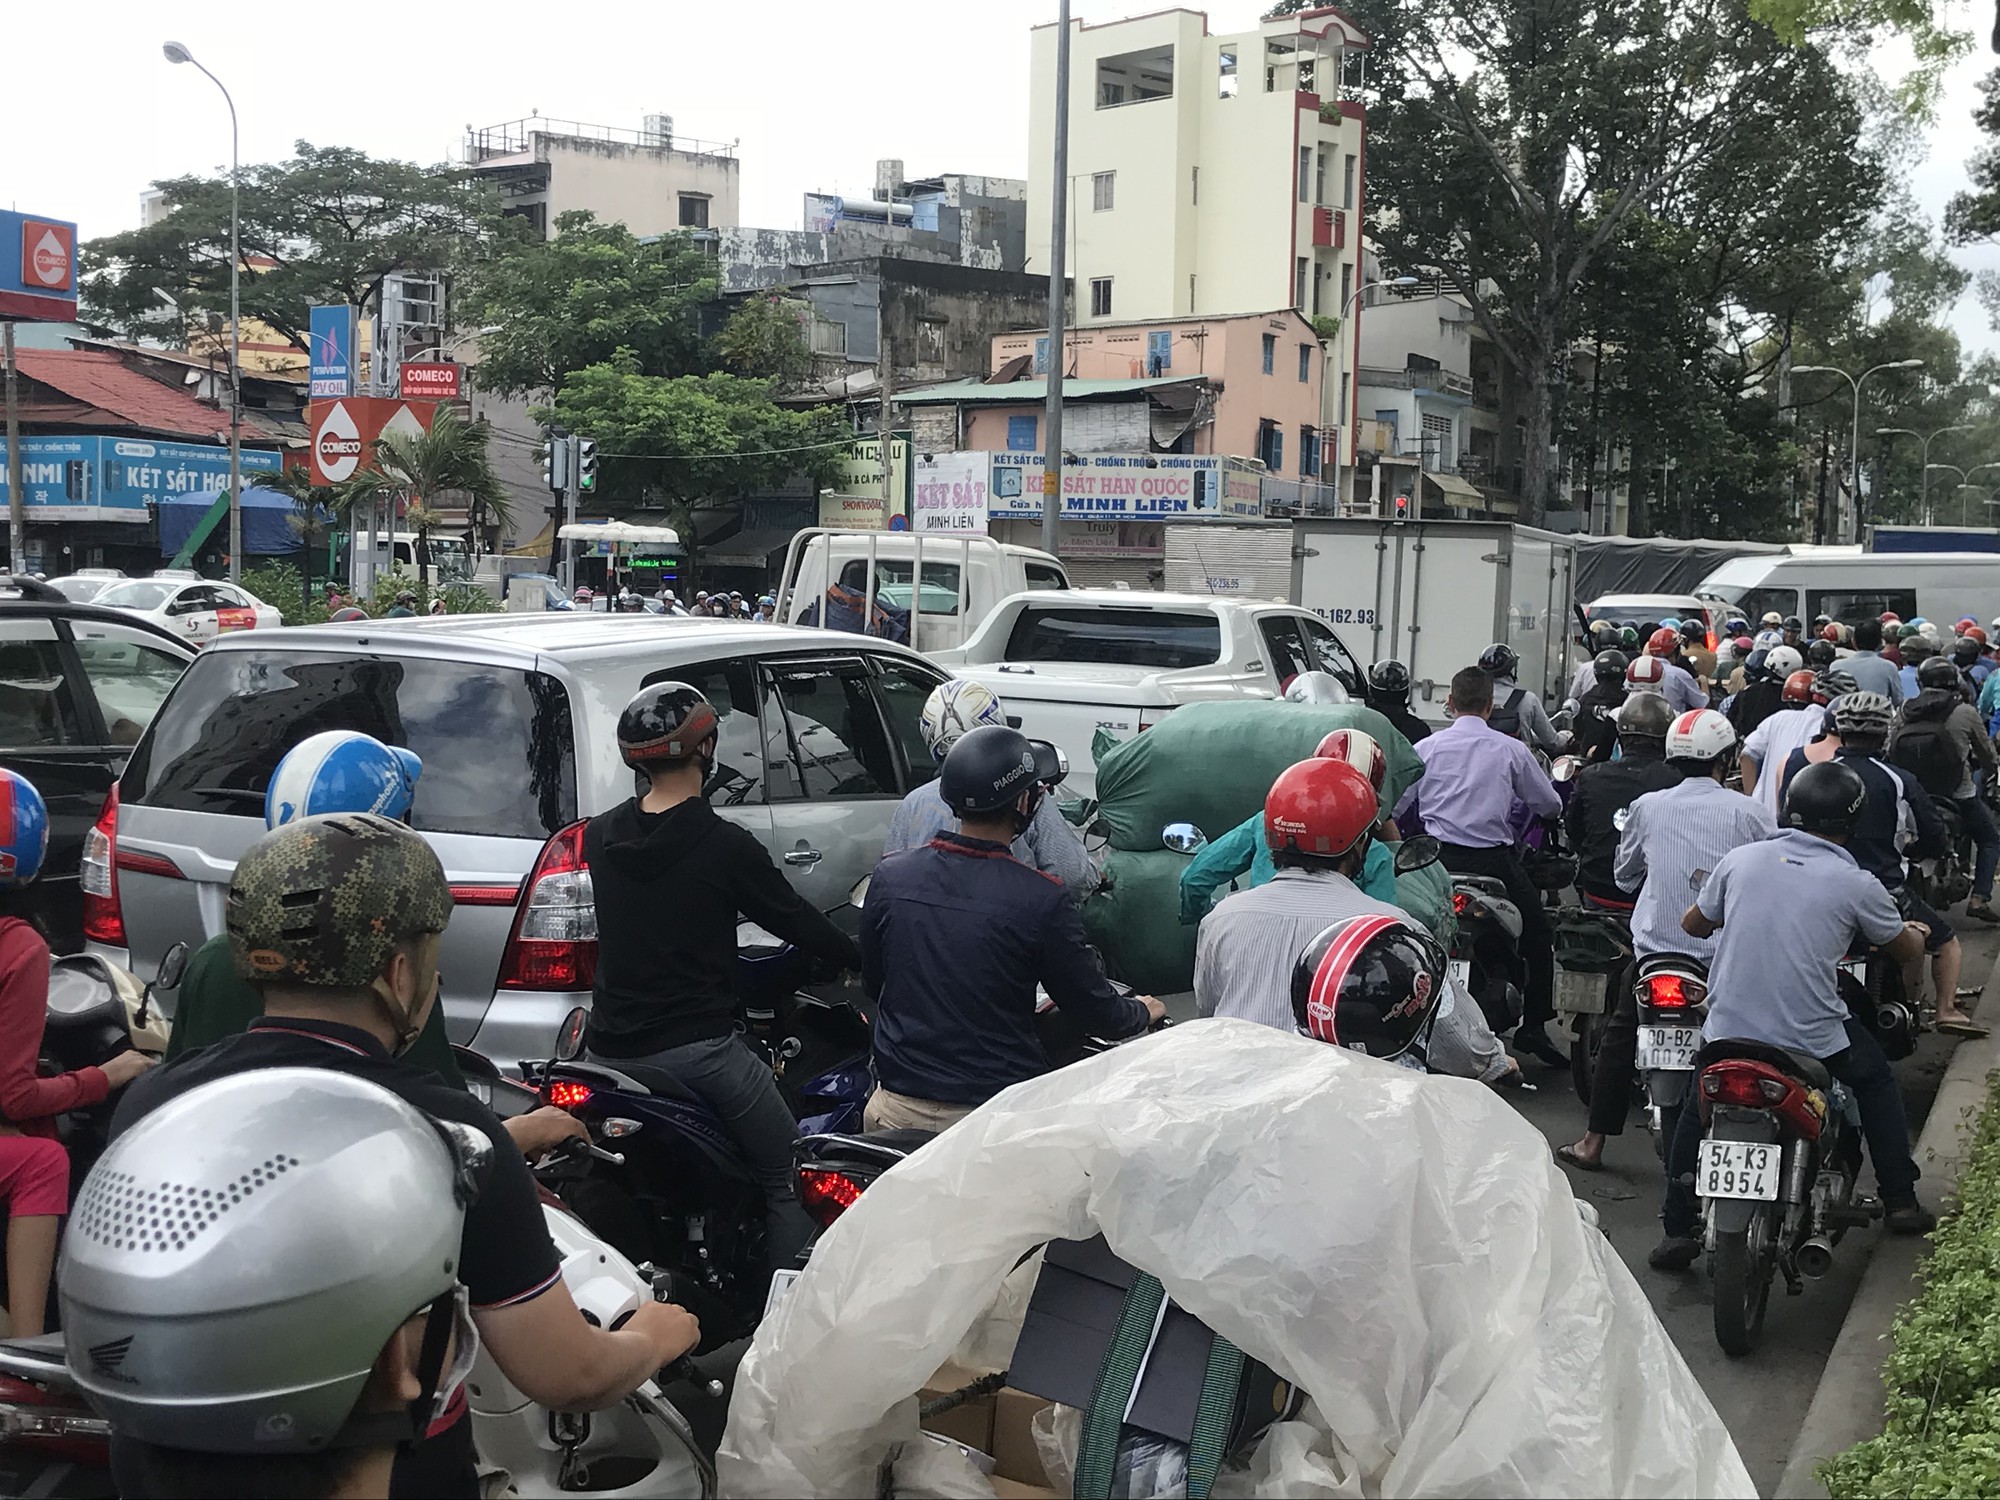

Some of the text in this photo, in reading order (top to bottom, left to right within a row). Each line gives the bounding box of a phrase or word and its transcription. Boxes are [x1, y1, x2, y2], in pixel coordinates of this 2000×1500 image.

[407, 369, 453, 383] COMECO
[313, 382, 345, 394] PV OIL
[321, 441, 361, 453] COMECO
[1095, 455, 1123, 467] CHỐNG
[1161, 456, 1191, 468] CHỐNG
[1193, 456, 1218, 468] CHÁY
[127, 463, 161, 489] KÉT
[166, 463, 198, 492] SẮT
[1100, 473, 1136, 495] HÀN
[1141, 472, 1189, 496] QUỐC
[917, 476, 950, 509] KÉT
[1067, 498, 1127, 511] MINH
[1134, 497, 1188, 511] LIÊN
[926, 512, 974, 529] MINH LIÊN
[1086, 520, 1117, 535] Truly
[1311, 608, 1374, 624] D-162.93
[1096, 721, 1129, 730] XLS
[993, 764, 1025, 791] PIAGGIO
[1311, 1004, 1330, 1017] New
[1711, 1145, 1768, 1170] 54-K3
[1708, 1169, 1765, 1196] 8954
